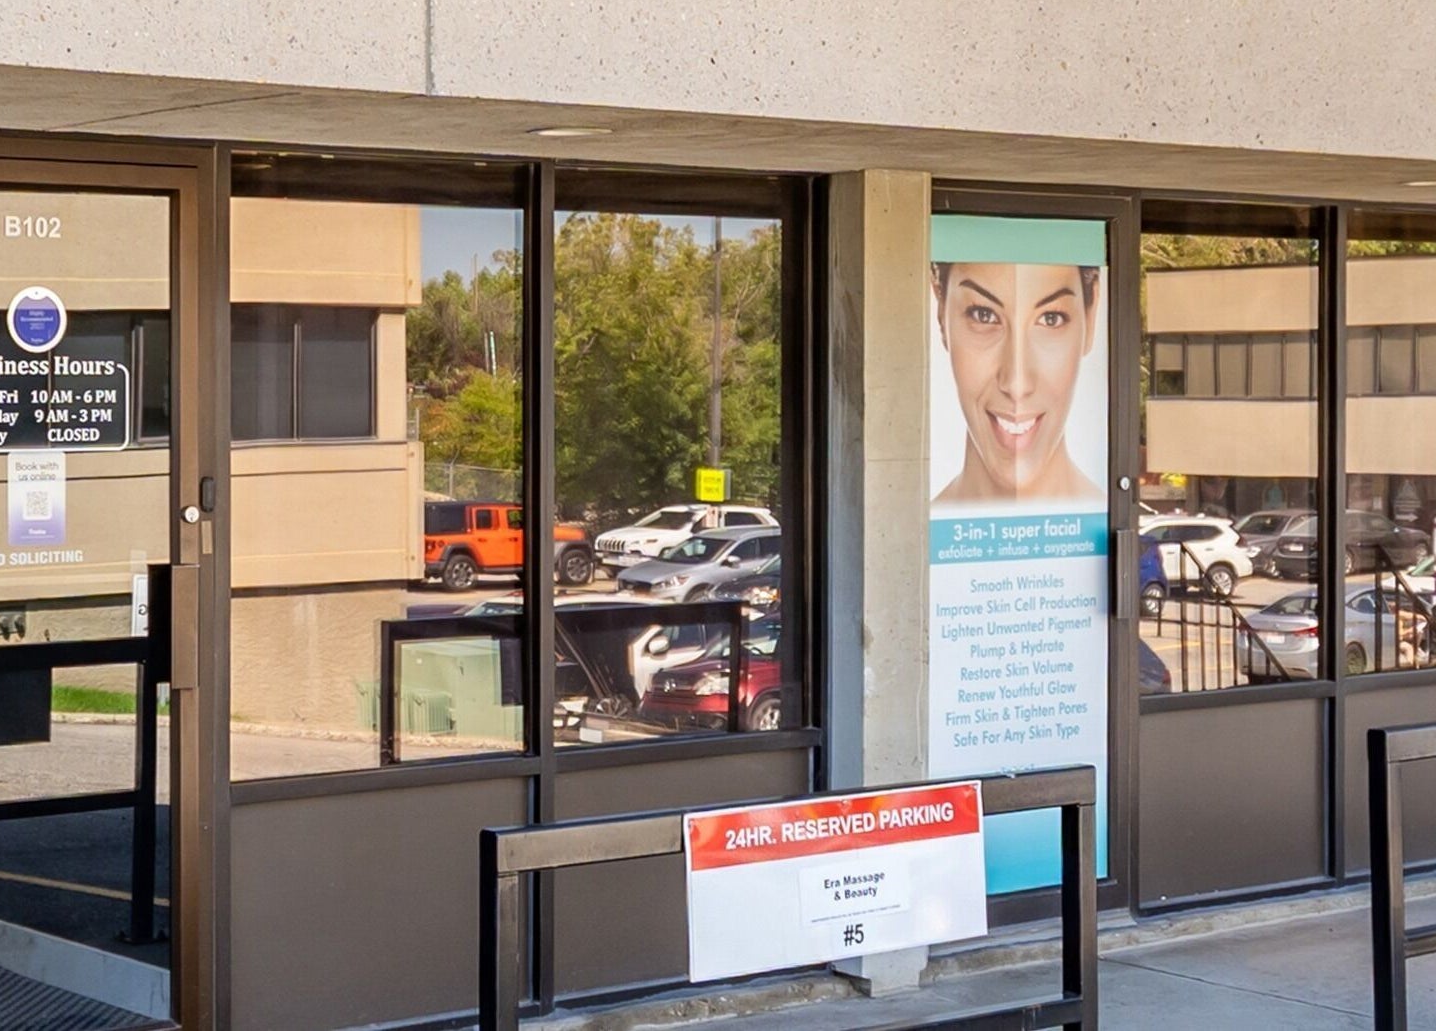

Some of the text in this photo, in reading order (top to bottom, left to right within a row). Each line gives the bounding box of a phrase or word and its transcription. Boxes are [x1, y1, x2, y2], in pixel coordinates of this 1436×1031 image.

[4, 215, 62, 239] B102
[54, 356, 115, 376] Hours
[30, 389, 49, 404] 10
[50, 389, 73, 404] AM
[83, 389, 92, 404] 6
[95, 389, 117, 404] PM
[34, 408, 44, 423] 9
[46, 408, 69, 423] AM
[79, 408, 88, 423] 3
[91, 408, 113, 423] PM
[47, 428, 100, 442] CLOSED
[953, 518, 1081, 543] 3-in-1 super facial
[9, 550, 84, 565] SOLICITING
[938, 544, 983, 559] exfoliate
[998, 543, 1029, 556] infuse
[1044, 540, 1095, 556] oxygenate
[970, 574, 1064, 593] Smooth Wrinkles
[936, 594, 1097, 619] Improve Skin Cell Production
[941, 616, 1092, 641] Lighten Unwanted Pigment
[970, 640, 1064, 660] Plump & Hydrate
[960, 660, 1074, 681] Restore Skin Volume
[958, 681, 1077, 703] Renew Youthful Glow
[945, 701, 1088, 726] Firm Skin & Tighten Pores
[953, 722, 1080, 748] Safe For Any Skin Type
[725, 801, 954, 851] 24HR. RESERVED PARKING
[824, 872, 885, 889] Era Massage
[844, 887, 877, 899] Beauty
[843, 923, 864, 947] #5
